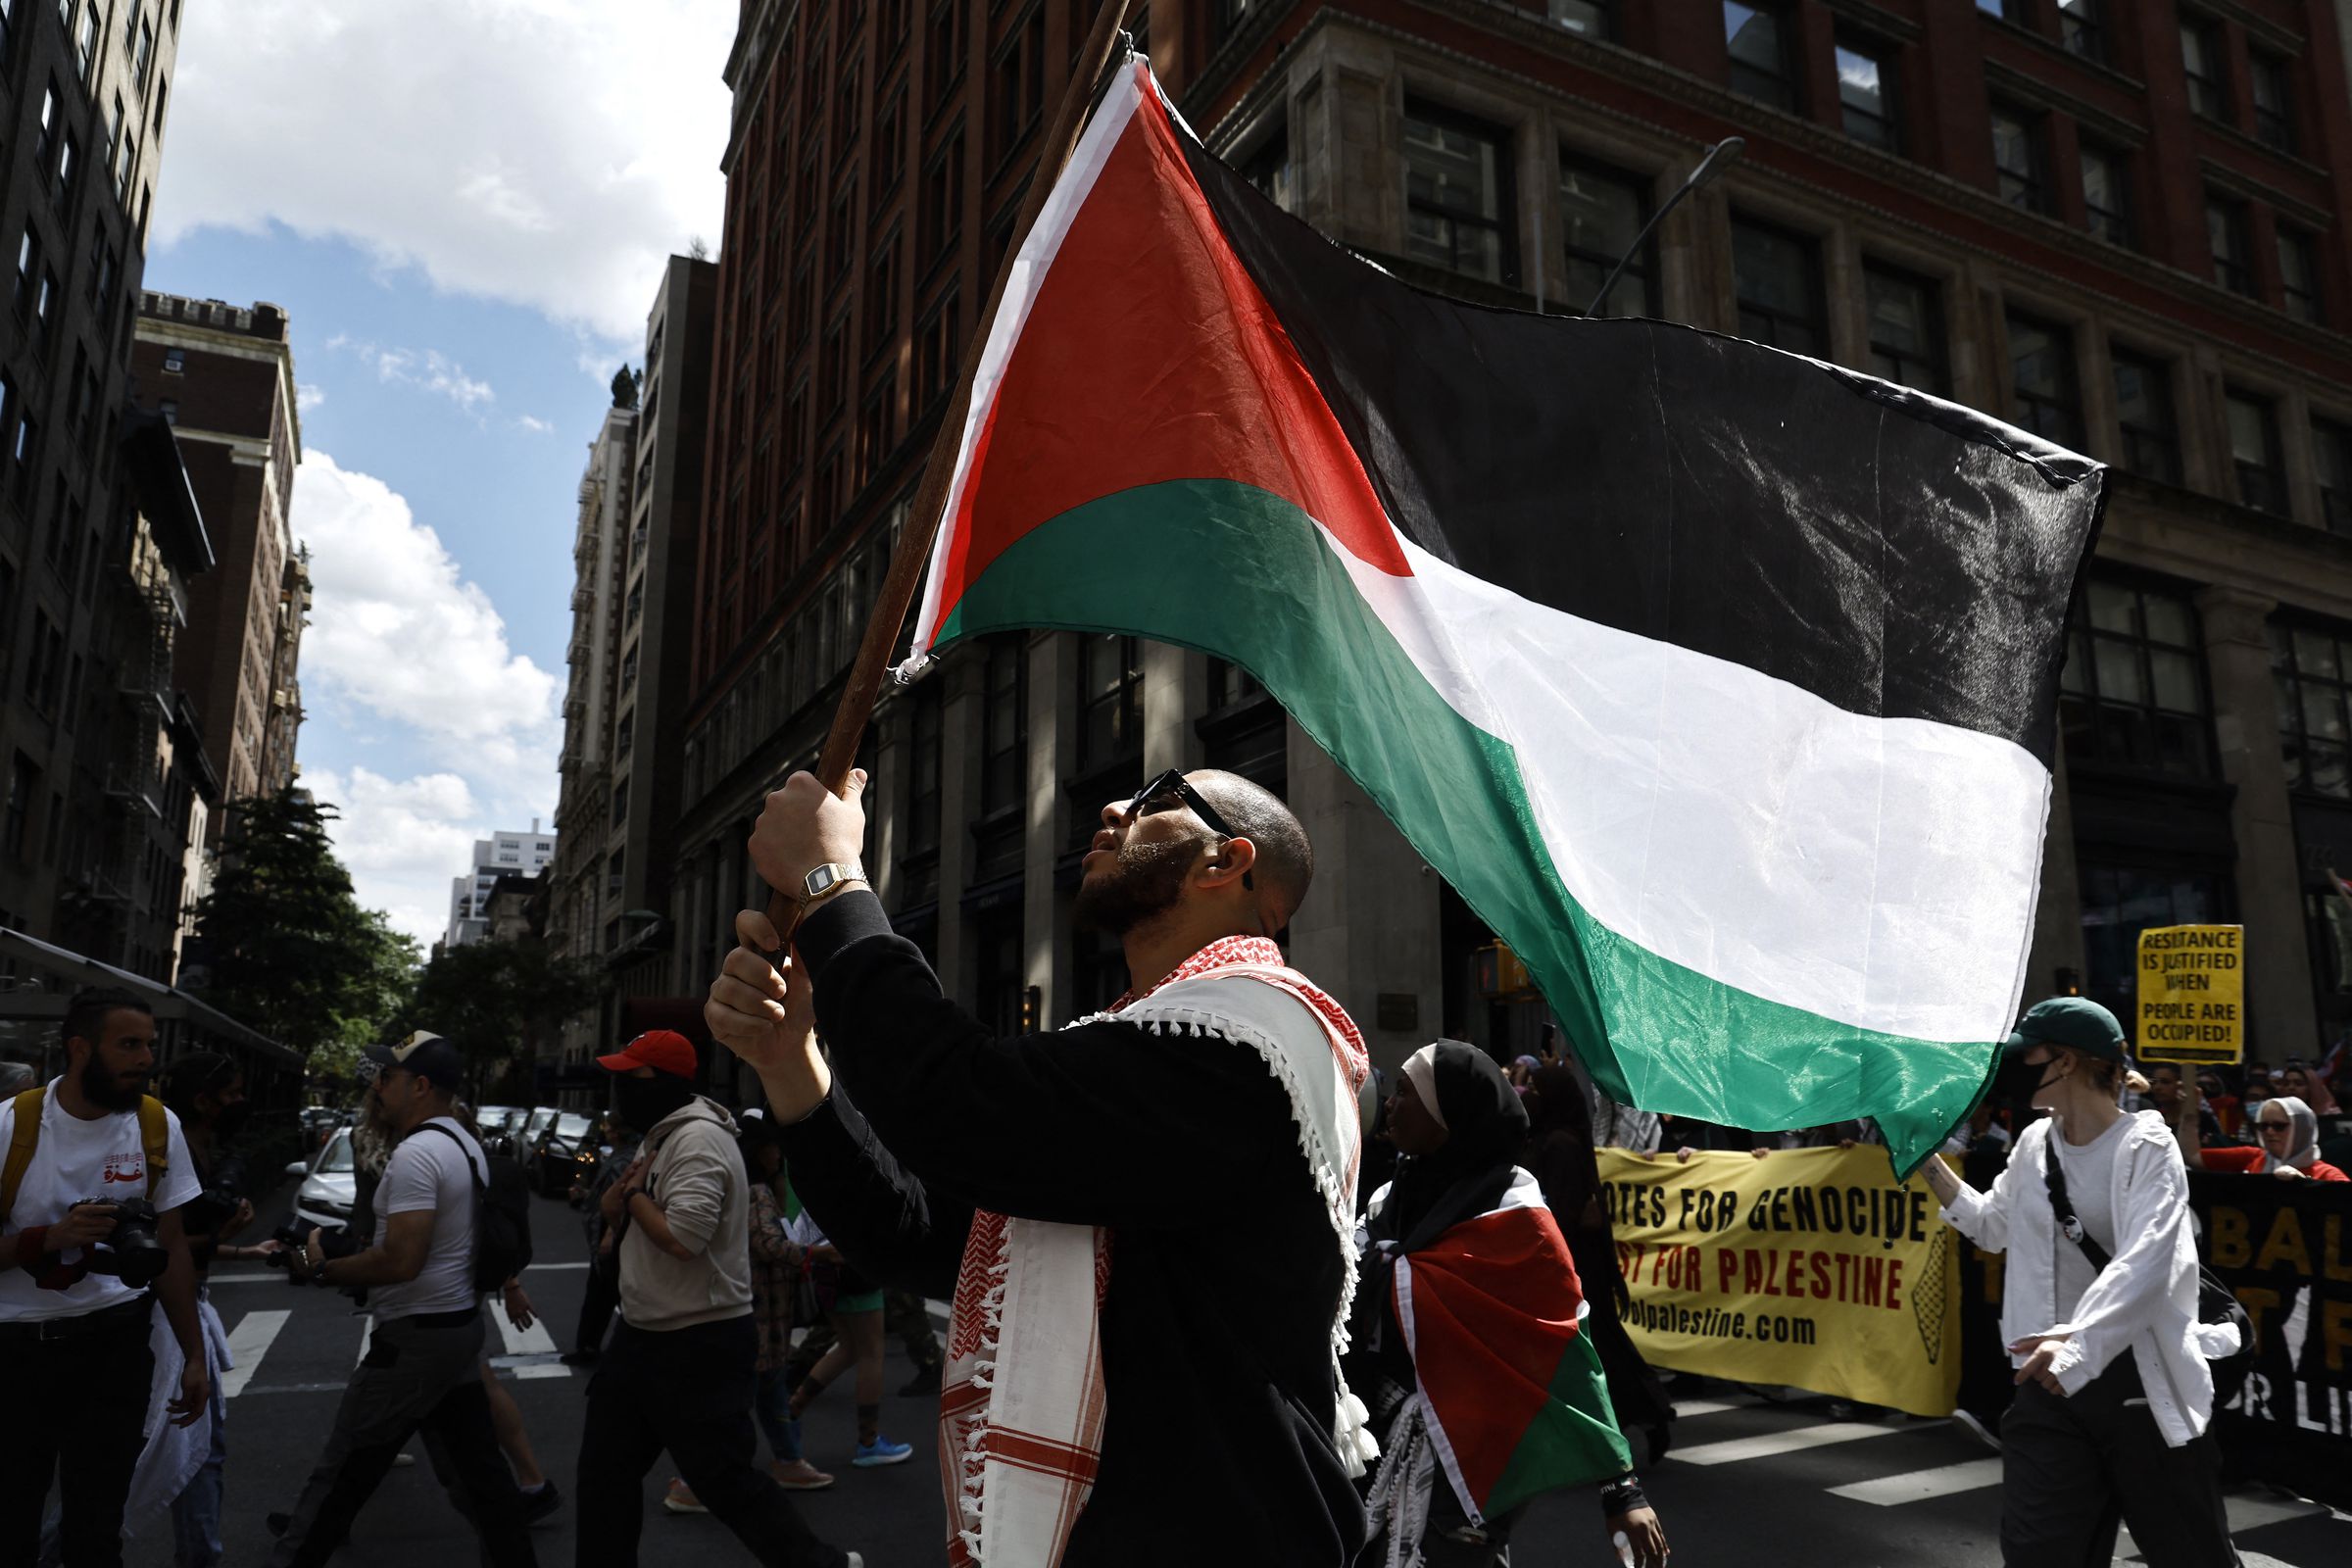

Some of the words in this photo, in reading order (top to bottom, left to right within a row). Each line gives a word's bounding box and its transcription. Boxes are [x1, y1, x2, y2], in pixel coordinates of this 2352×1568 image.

[2143, 955, 2158, 969] IS
[2166, 974, 2209, 990] WHEN
[2144, 1004, 2195, 1019] PEOPLE
[2202, 1004, 2235, 1020] ARE
[2148, 1025, 2230, 1042] OCCUPIED!
[1602, 1181, 1665, 1228] OTES
[1680, 1189, 1737, 1232] FOR
[1748, 1187, 1927, 1242] GENOCIDE
[1652, 1244, 1701, 1291] FOR
[1719, 1249, 1902, 1309] PALESTINE
